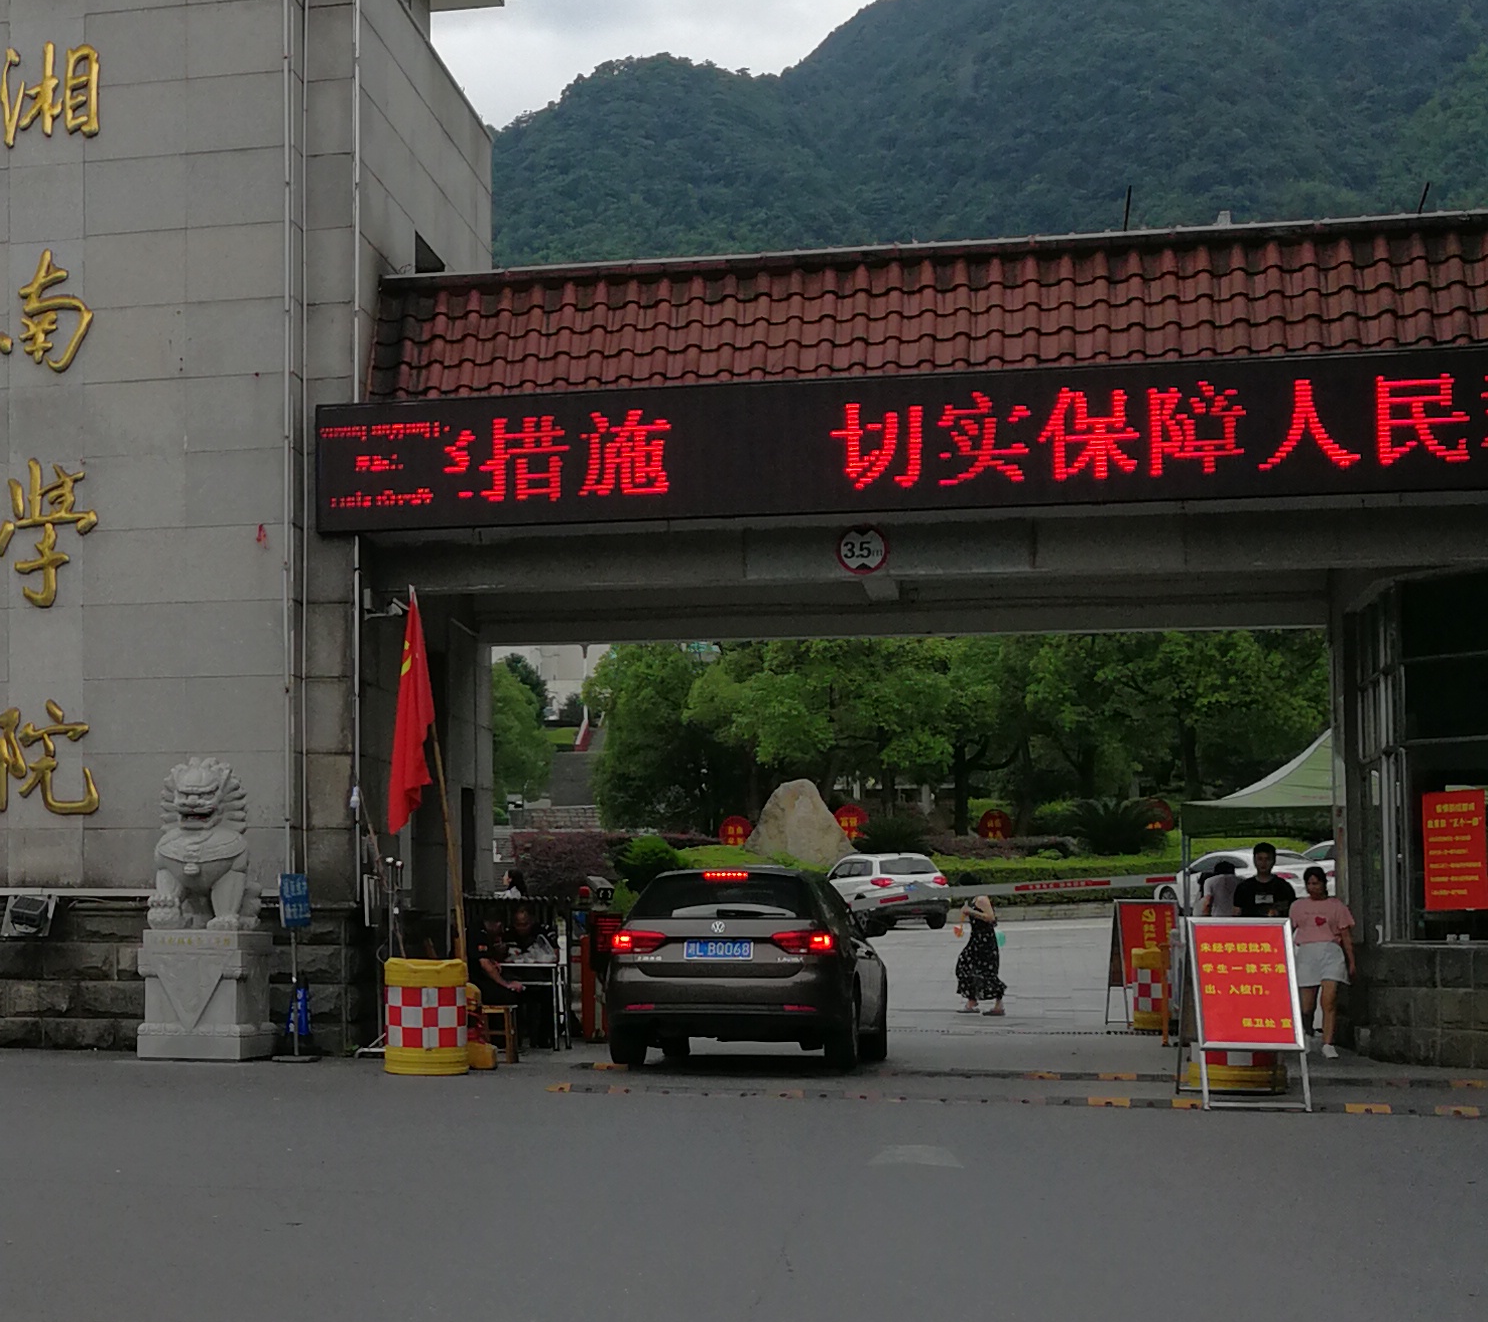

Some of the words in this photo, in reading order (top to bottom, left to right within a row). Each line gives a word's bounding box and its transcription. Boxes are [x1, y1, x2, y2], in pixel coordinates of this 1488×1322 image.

[829, 372, 1488, 490] 切实保障人民
